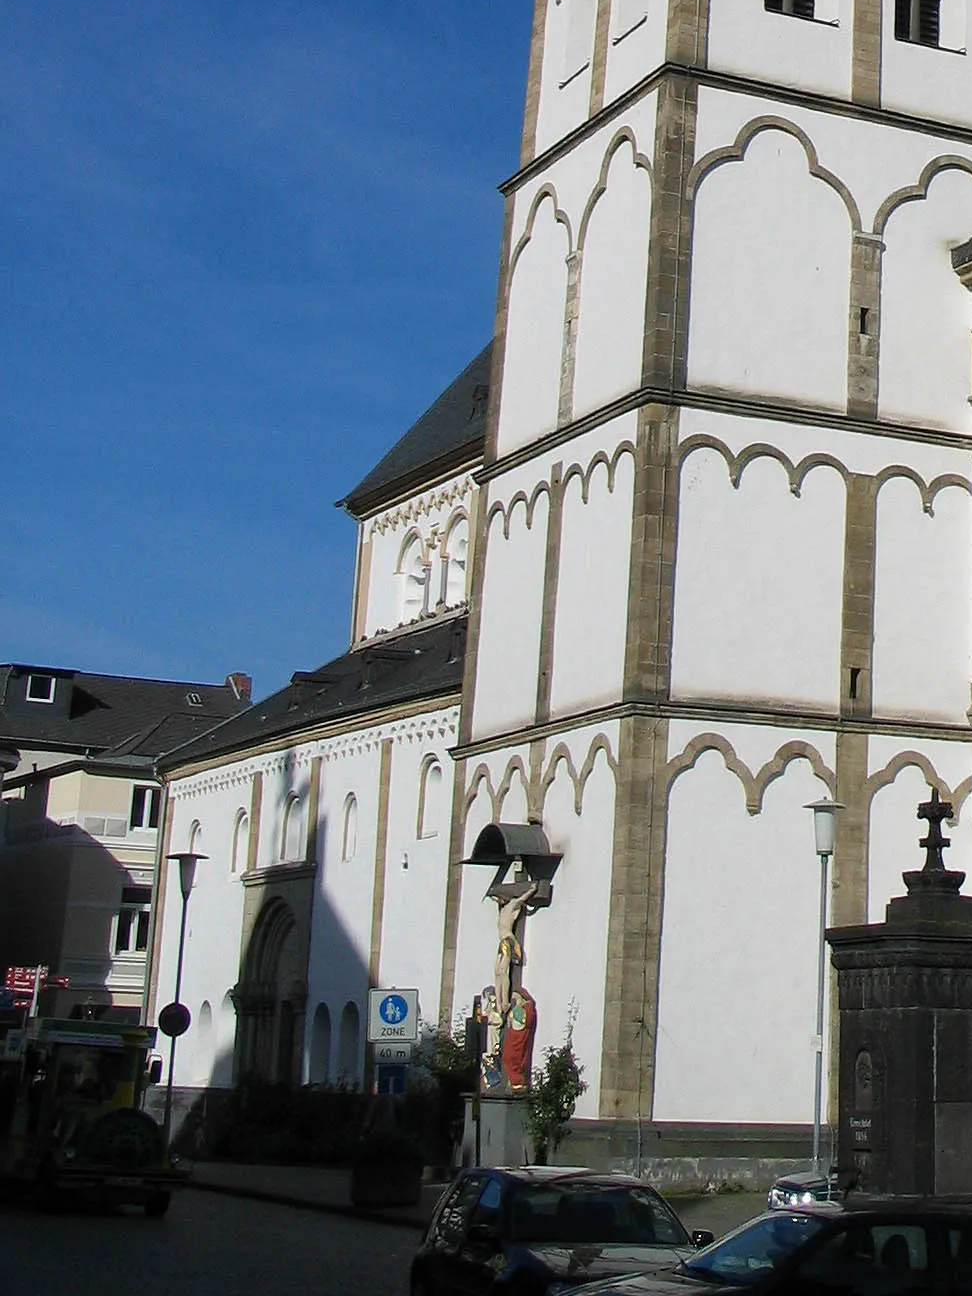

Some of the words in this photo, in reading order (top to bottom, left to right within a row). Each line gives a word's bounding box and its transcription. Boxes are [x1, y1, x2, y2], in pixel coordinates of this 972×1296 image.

[381, 1027, 406, 1037] ZONE
[380, 1048, 391, 1058] 40
[396, 1050, 406, 1058] m
